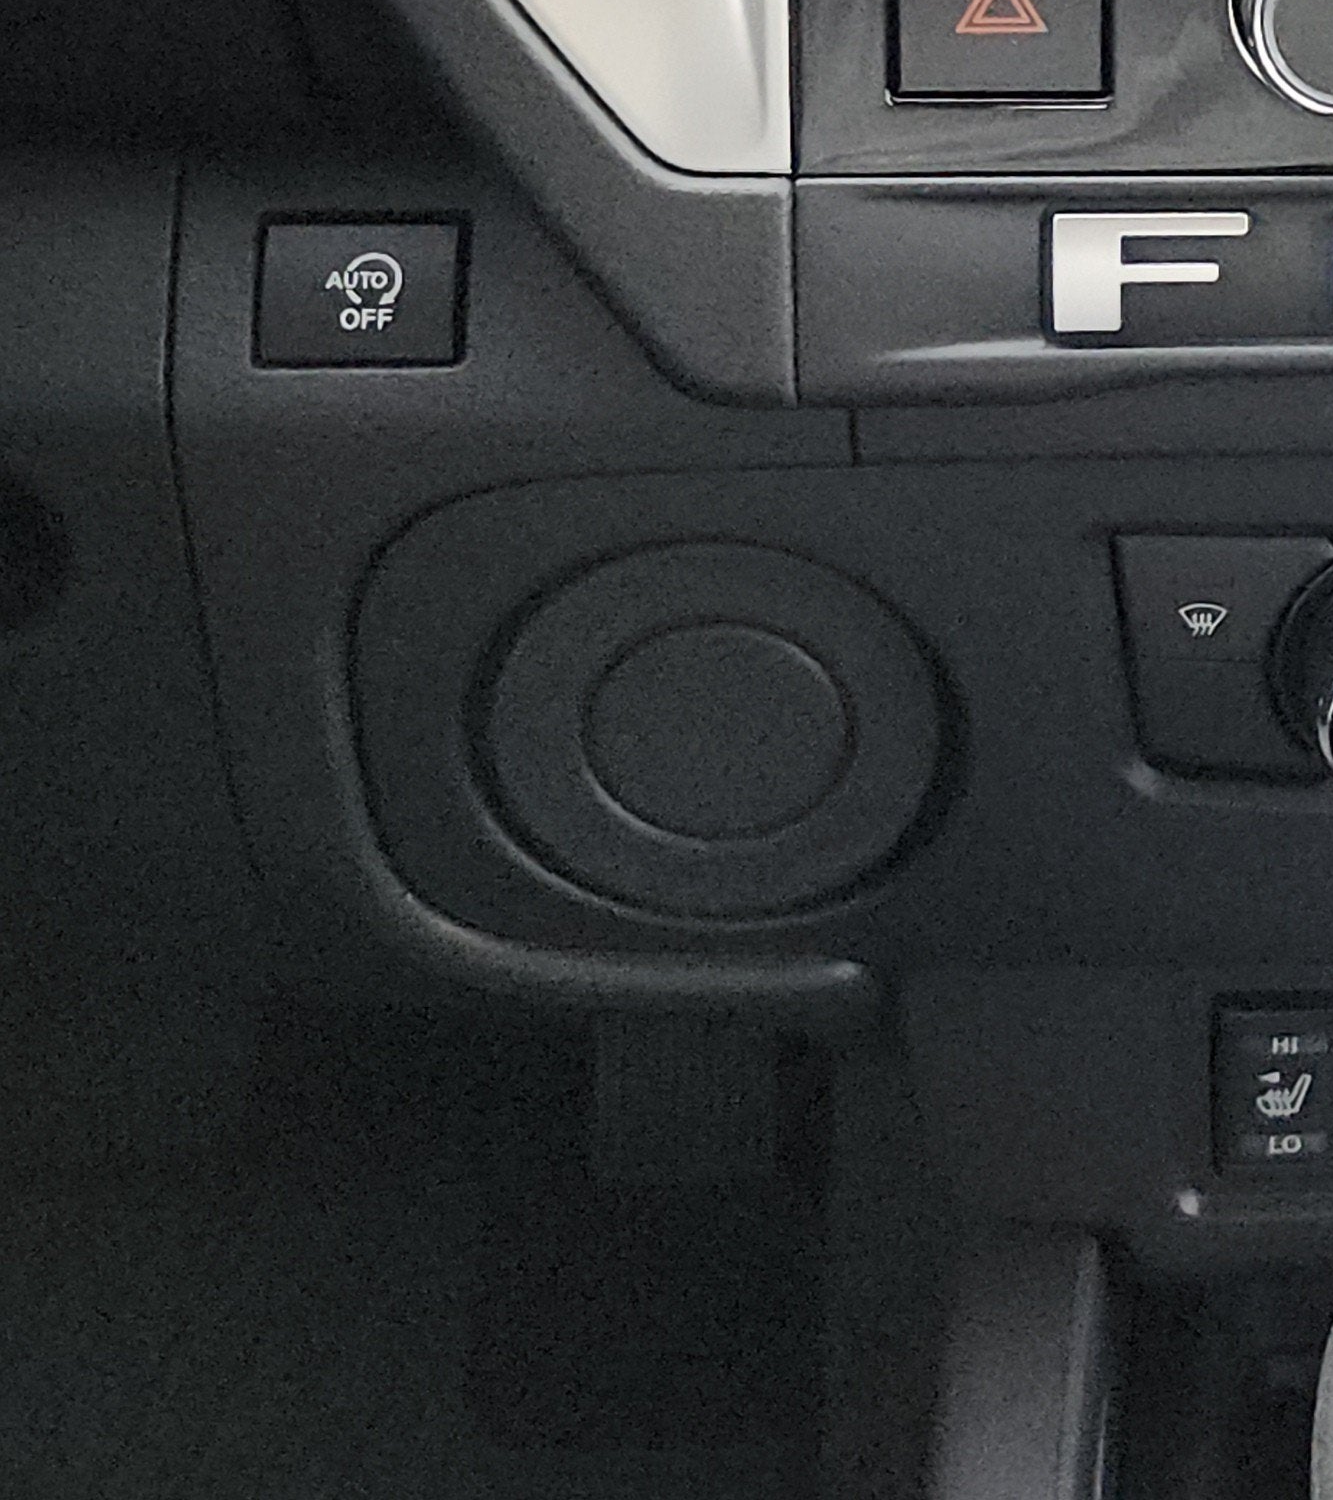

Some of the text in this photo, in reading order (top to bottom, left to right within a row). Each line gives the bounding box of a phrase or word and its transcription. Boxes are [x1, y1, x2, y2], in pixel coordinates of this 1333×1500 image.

[325, 270, 389, 290] AUTO
[340, 308, 394, 331] OFF
[1272, 1037, 1300, 1054] HI
[1268, 1135, 1303, 1156] LO
